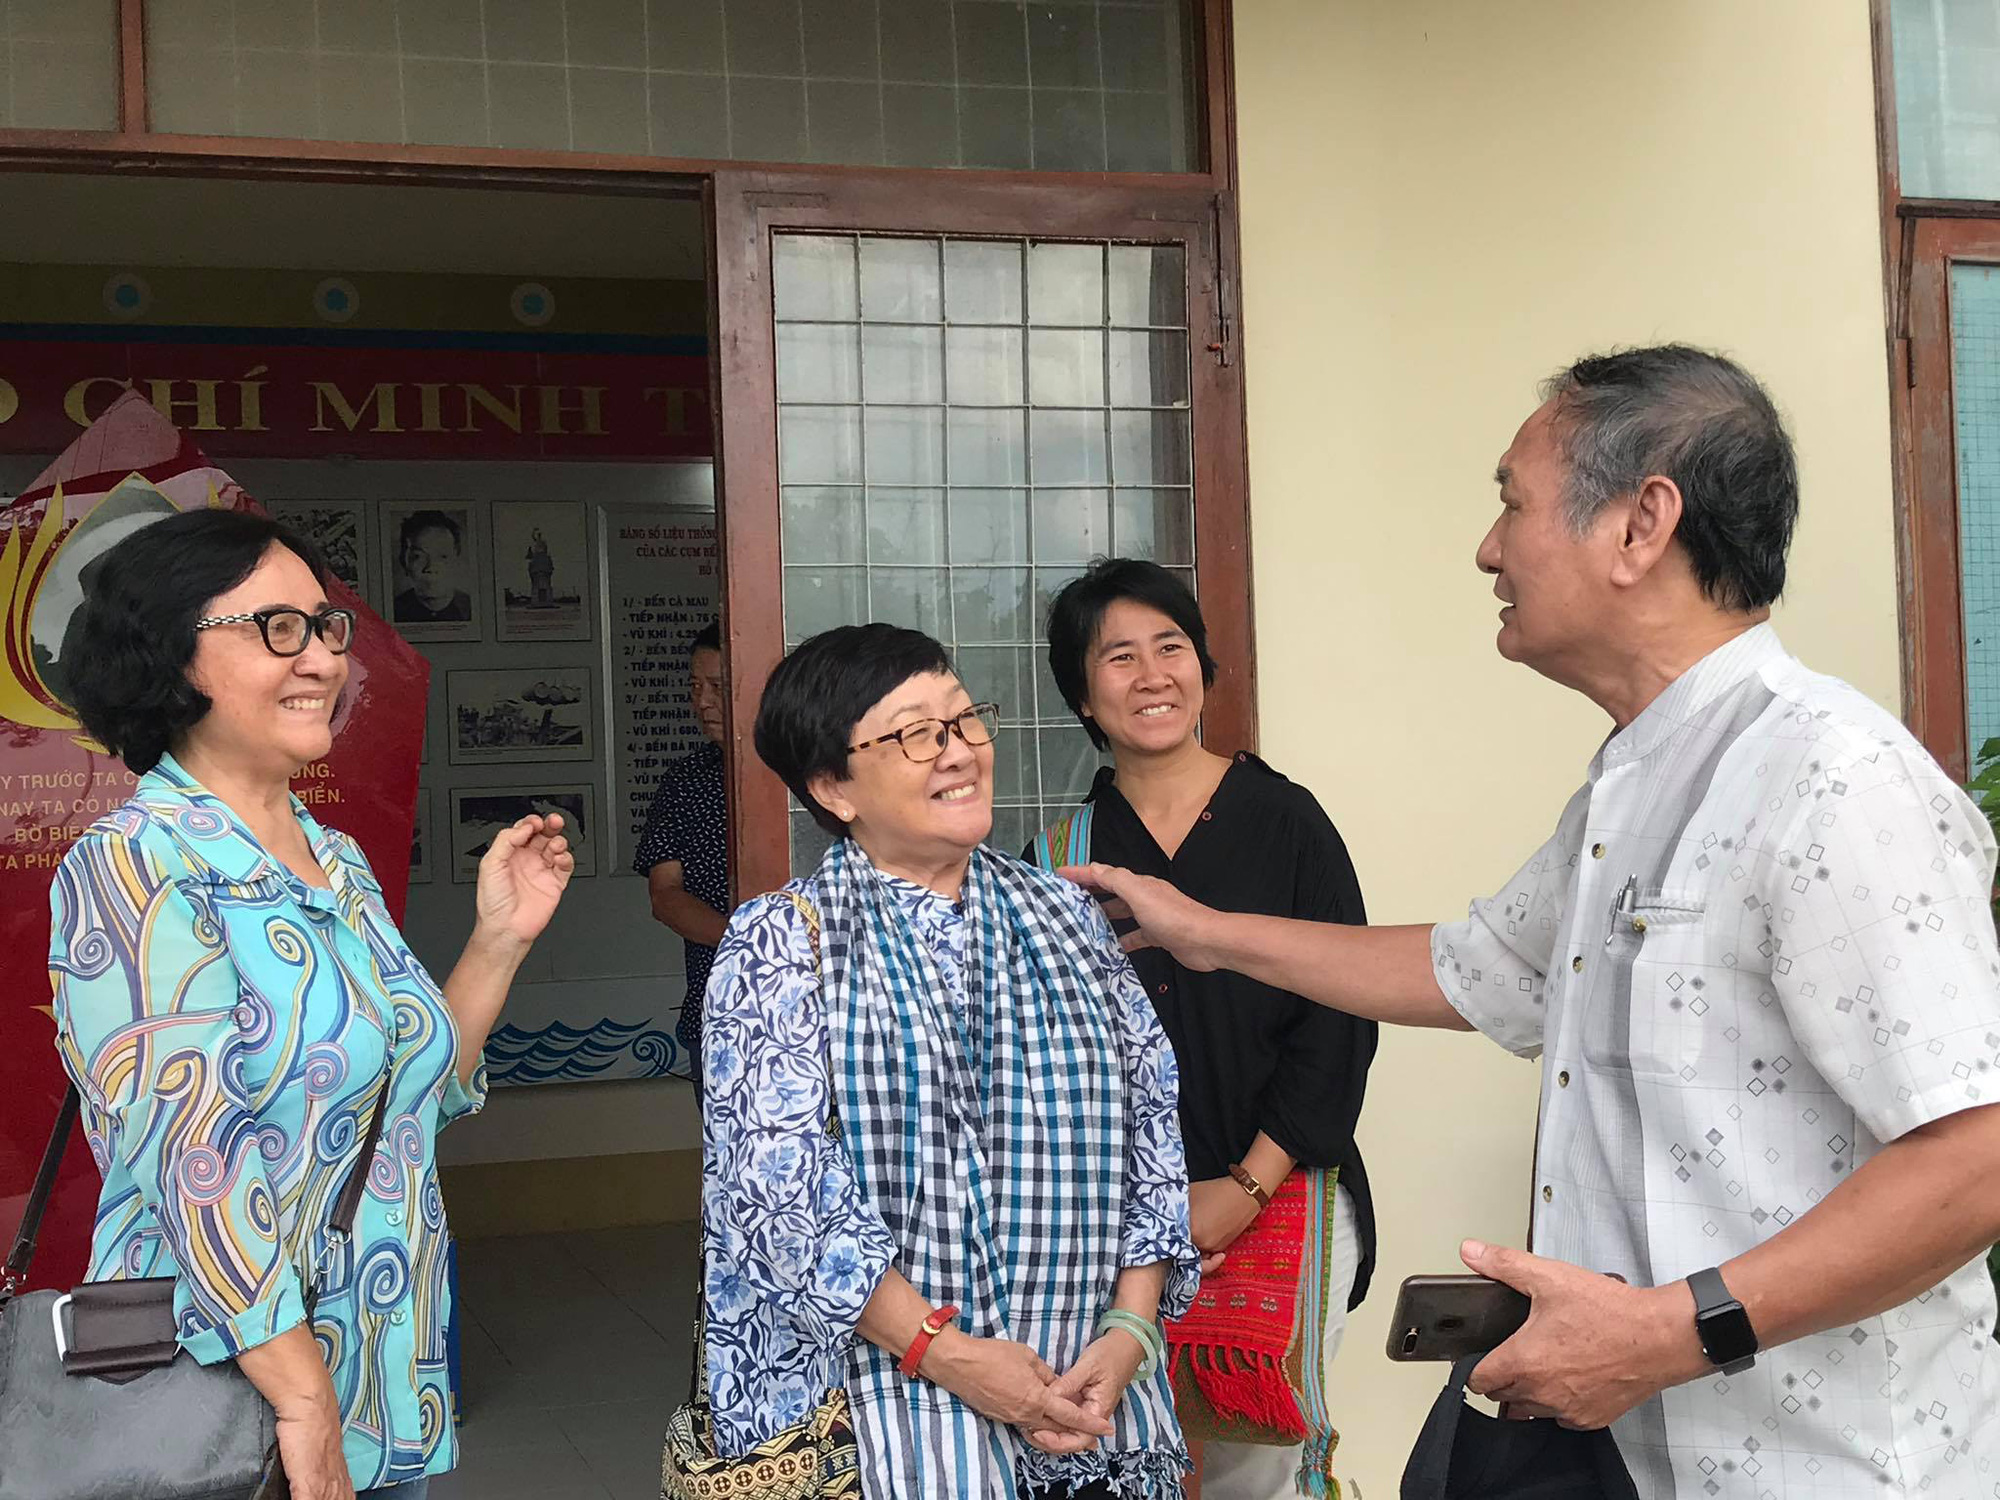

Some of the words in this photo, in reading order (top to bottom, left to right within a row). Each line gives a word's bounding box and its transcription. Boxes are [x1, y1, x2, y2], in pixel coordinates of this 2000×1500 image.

[63, 364, 270, 431] CHÍ
[307, 381, 611, 436] MINH
[686, 597, 708, 606] MAU
[631, 658, 655, 671] TIẾP
[659, 659, 689, 673] NHẬN
[633, 706, 657, 719] TIẾP
[659, 707, 690, 721] NHẬN
[18, 769, 86, 789] TRƯỚC
[92, 772, 117, 787] TA
[41, 800, 66, 815] TA
[72, 795, 99, 813] CÓ
[296, 781, 345, 804] BIỂN.
[15, 823, 43, 842] BỜ
